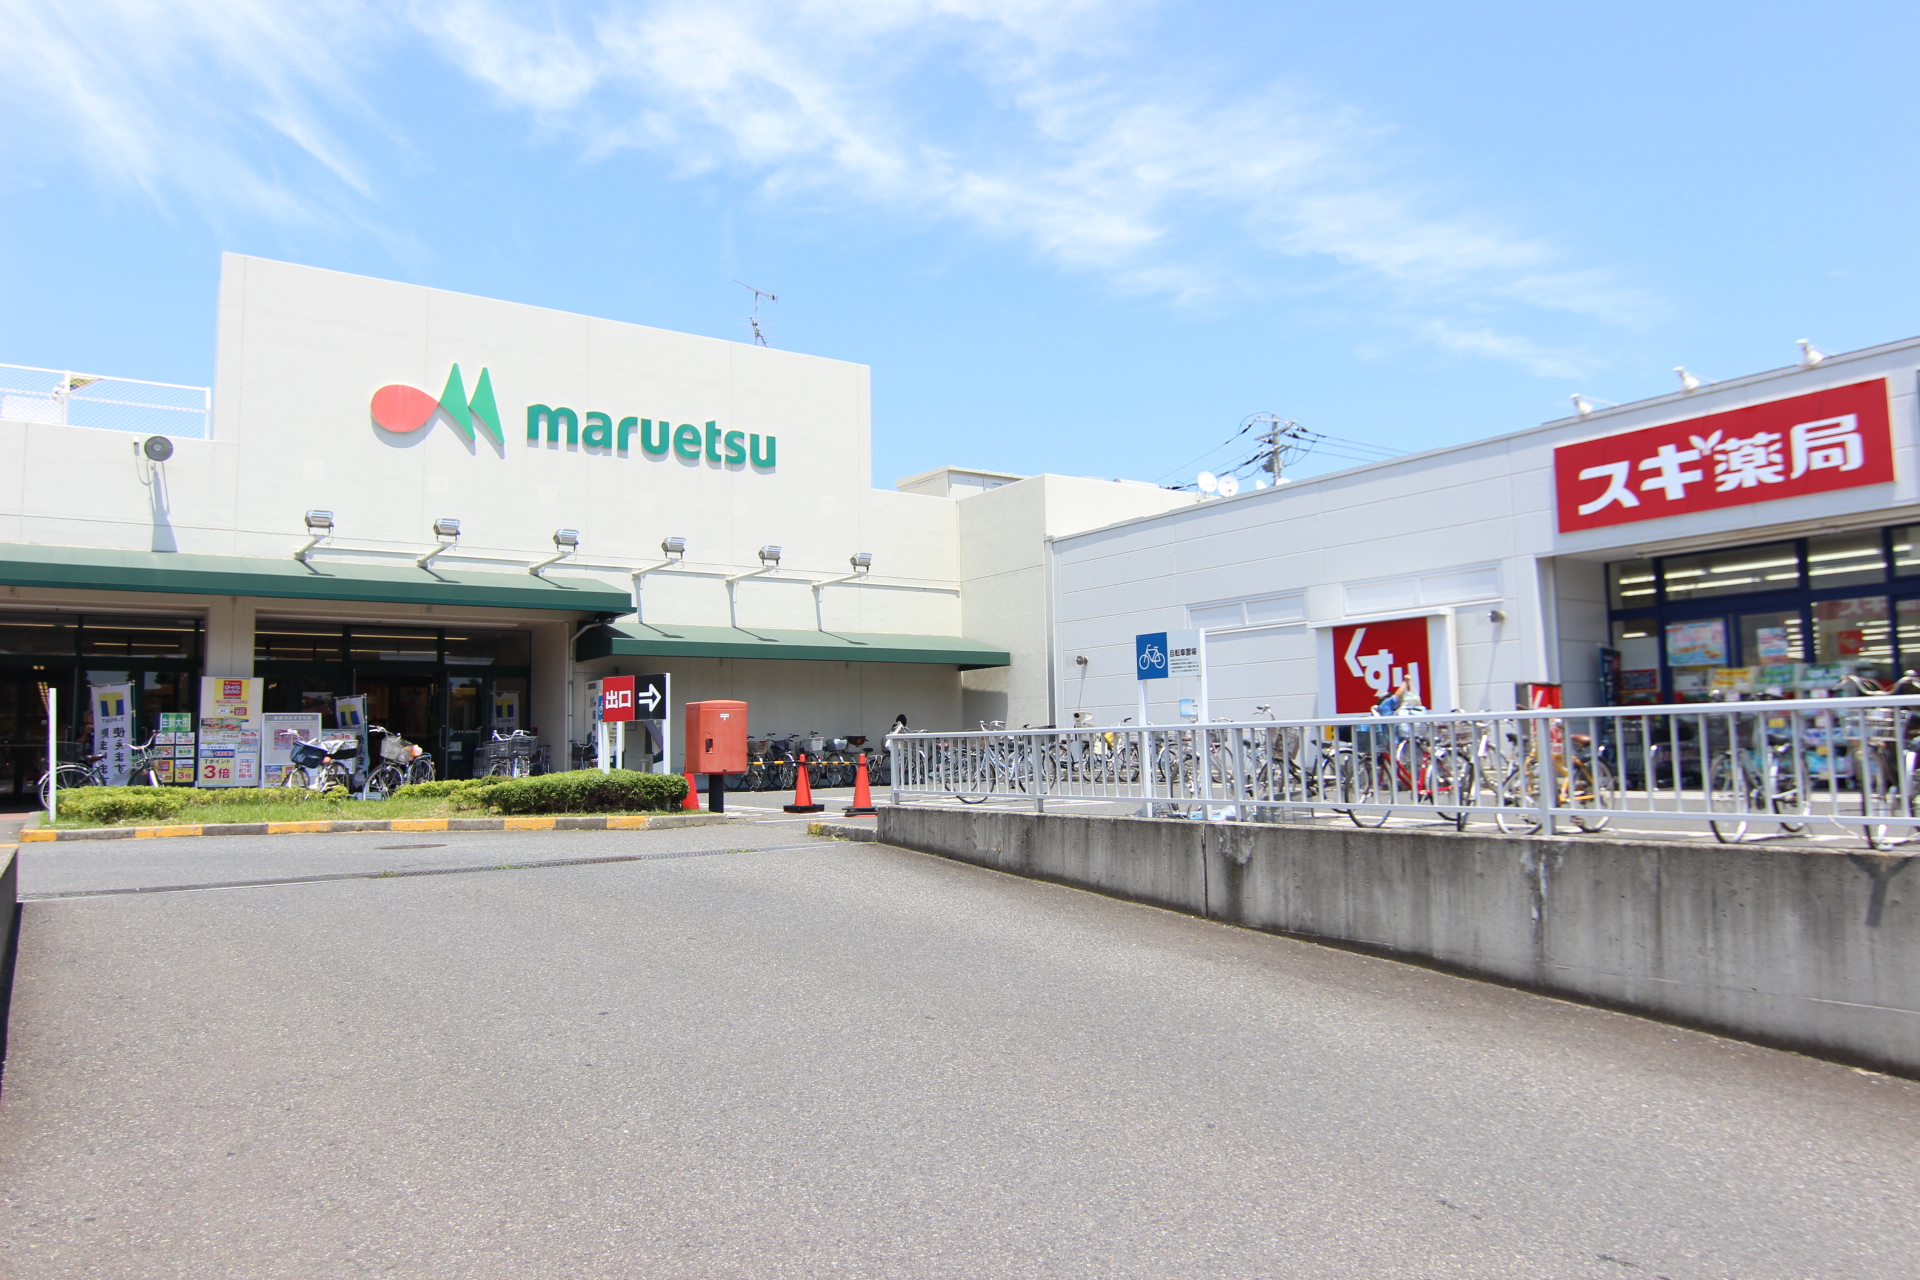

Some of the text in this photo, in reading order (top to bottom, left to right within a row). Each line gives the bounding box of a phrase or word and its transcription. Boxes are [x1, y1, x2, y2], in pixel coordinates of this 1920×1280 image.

[527, 403, 777, 468] maruetsu
[1578, 413, 1865, 516] スギ薬局
[1344, 627, 1421, 697] くすり
[605, 690, 632, 710] 出口
[177, 771, 192, 780] 3倍
[203, 765, 230, 779] 3倍
